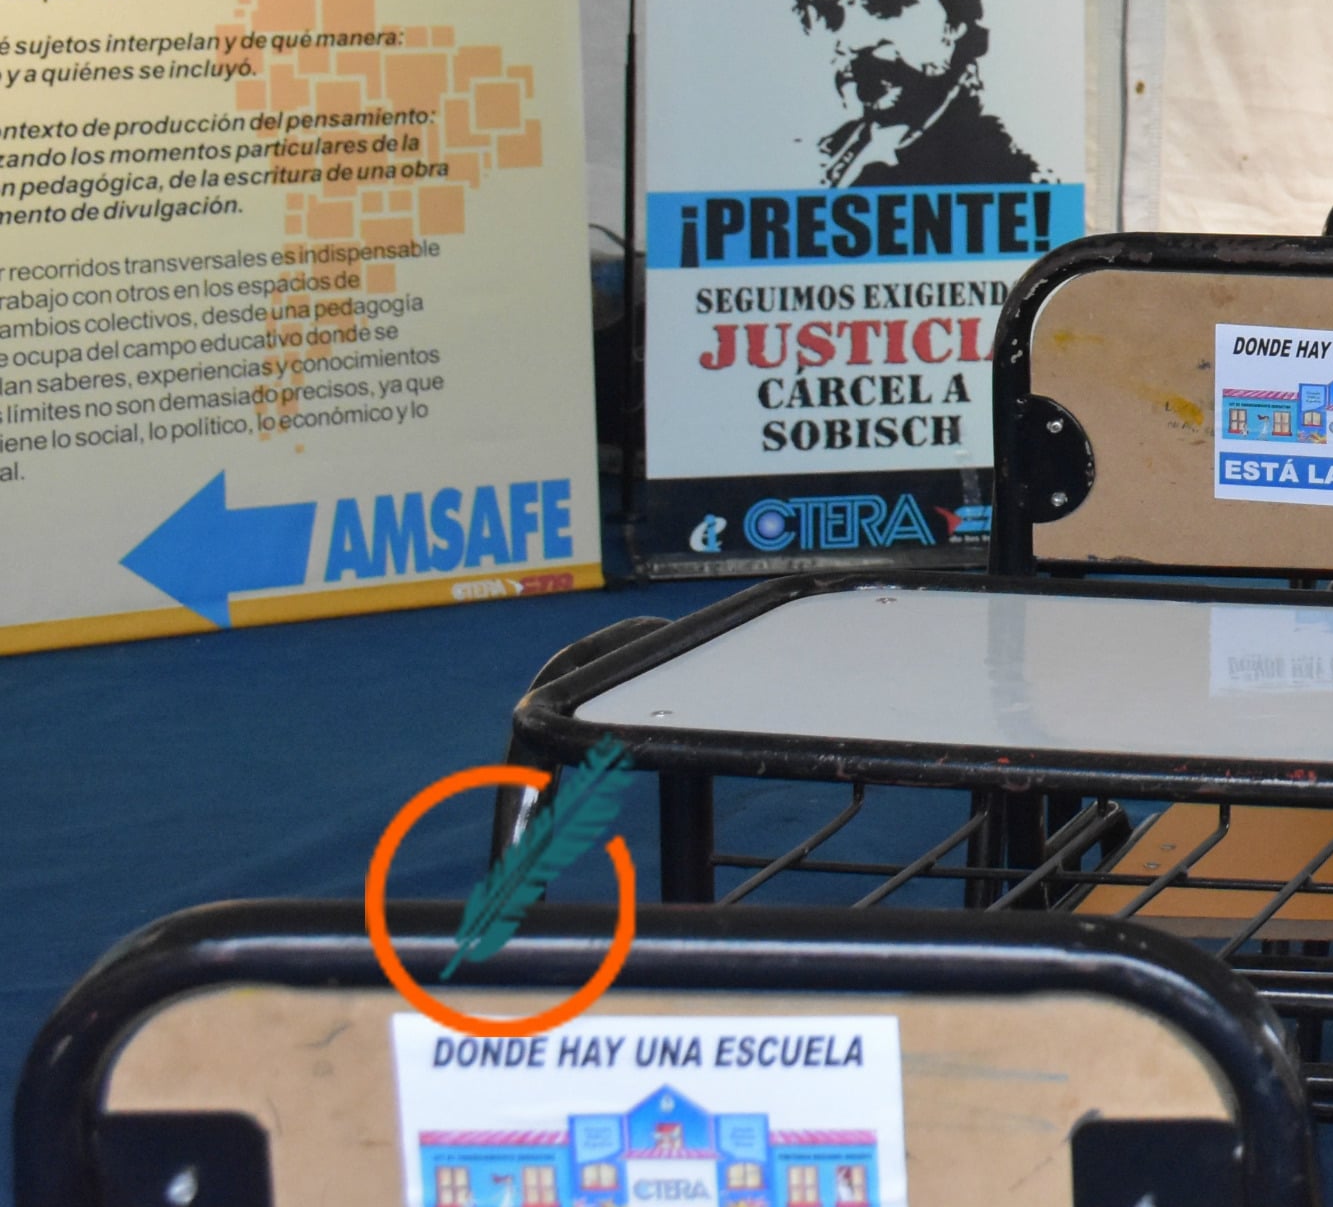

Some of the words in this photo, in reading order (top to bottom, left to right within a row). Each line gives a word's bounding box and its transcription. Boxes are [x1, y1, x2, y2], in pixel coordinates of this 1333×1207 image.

[71, 201, 99, 222] de
[103, 197, 243, 223] divulgación.
[679, 190, 1051, 269] ¡PRESENTE!
[9, 256, 120, 281] recorridos
[124, 250, 267, 274] transversales
[271, 249, 296, 265] es
[299, 240, 441, 269] indispensable
[84, 308, 198, 335] colectivos,
[202, 301, 267, 325] desde
[271, 303, 310, 321] una
[314, 295, 423, 325] pedagogía
[696, 284, 855, 314] SEGUIMOS
[864, 281, 1009, 309] EXIGIEND
[1233, 337, 1292, 358] DONDE
[1296, 340, 1332, 359] HAY
[37, 369, 132, 394] saberes,
[137, 360, 272, 388] experiencias
[276, 361, 289, 378] y
[291, 347, 441, 374] conocimientos
[757, 367, 932, 409] CÁRCEL
[942, 372, 971, 404] A
[762, 415, 962, 452] SOBISCH
[1224, 459, 1299, 483] ESTÁ
[324, 478, 573, 583] AMSAFE
[743, 494, 936, 551] CTERA
[433, 1036, 547, 1068] DONDE
[557, 1036, 625, 1068] HAY
[635, 1036, 702, 1068] UNA
[713, 1035, 865, 1067] ESCUELA
